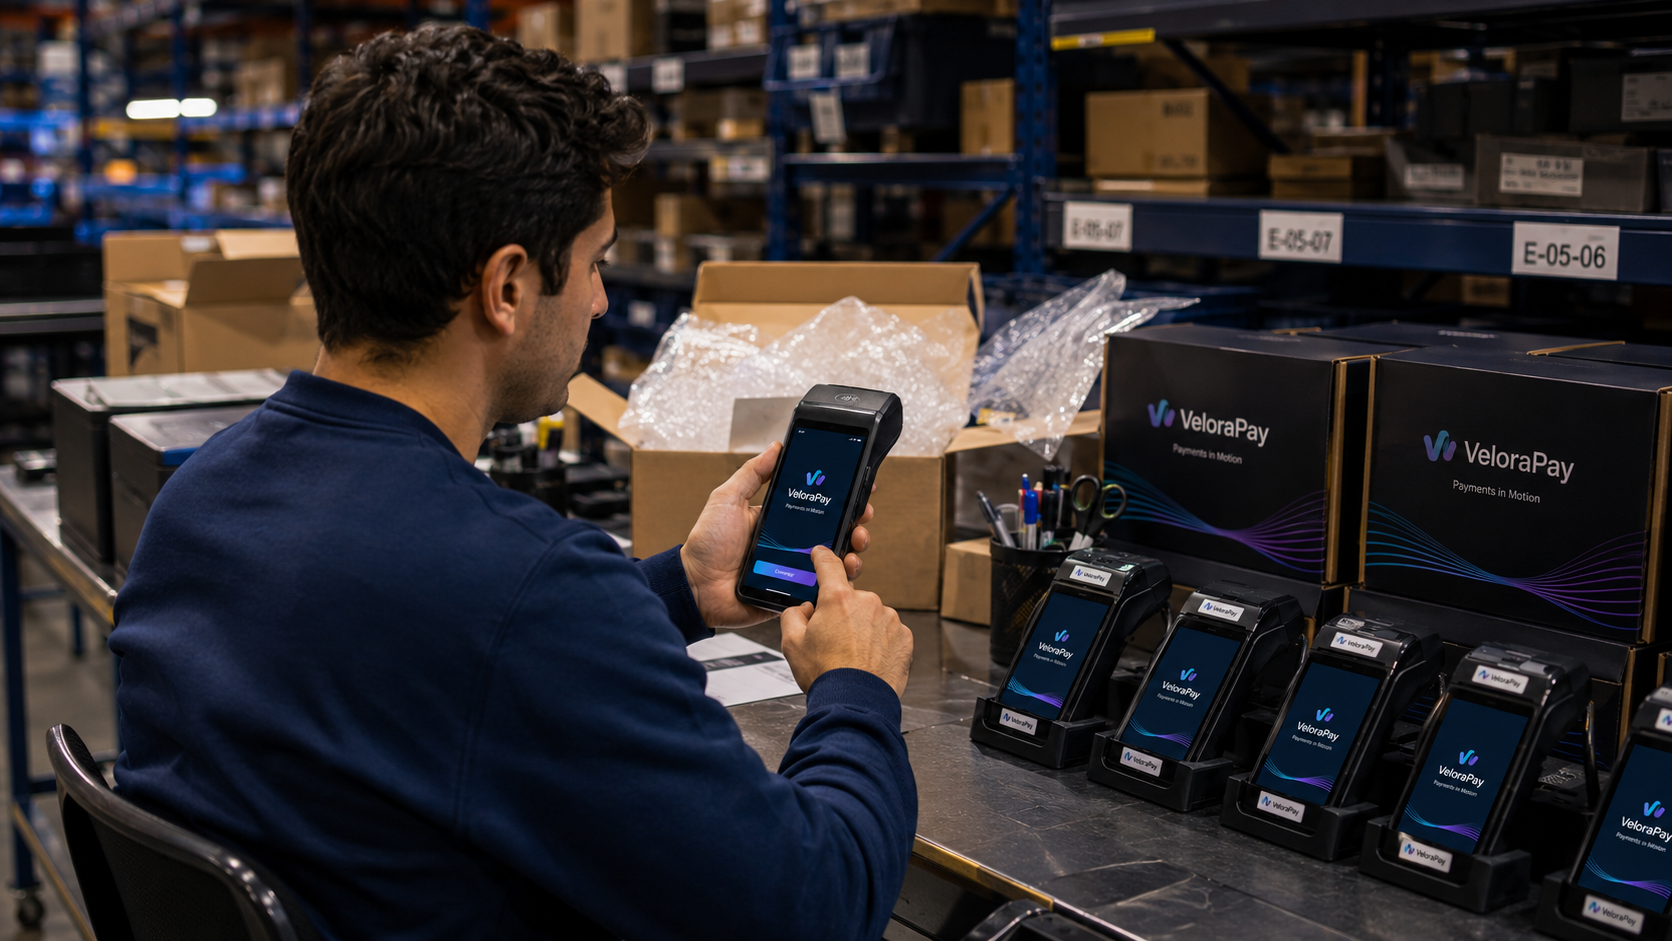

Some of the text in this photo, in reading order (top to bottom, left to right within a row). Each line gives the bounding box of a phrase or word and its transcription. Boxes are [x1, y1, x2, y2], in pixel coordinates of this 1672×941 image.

[1267, 228, 1333, 254] E-05-07
[1523, 241, 1606, 269] E-05-06
[1180, 408, 1269, 447] VeloraPay
[1173, 443, 1242, 465] Payments in Motion
[1464, 440, 1575, 484] VeloraPay
[788, 487, 832, 506] VeloraPay
[1453, 479, 1541, 504] Payments in Motion
[1038, 641, 1074, 660] VeloraPay
[1162, 680, 1201, 700] VeloraPay
[1297, 721, 1340, 743] VeloraPay
[1438, 764, 1485, 789] VeloraPay
[1621, 815, 1672, 843] VeloraPay
[1416, 848, 1446, 867] VeloraPay
[1602, 906, 1636, 928] VeloraPay
